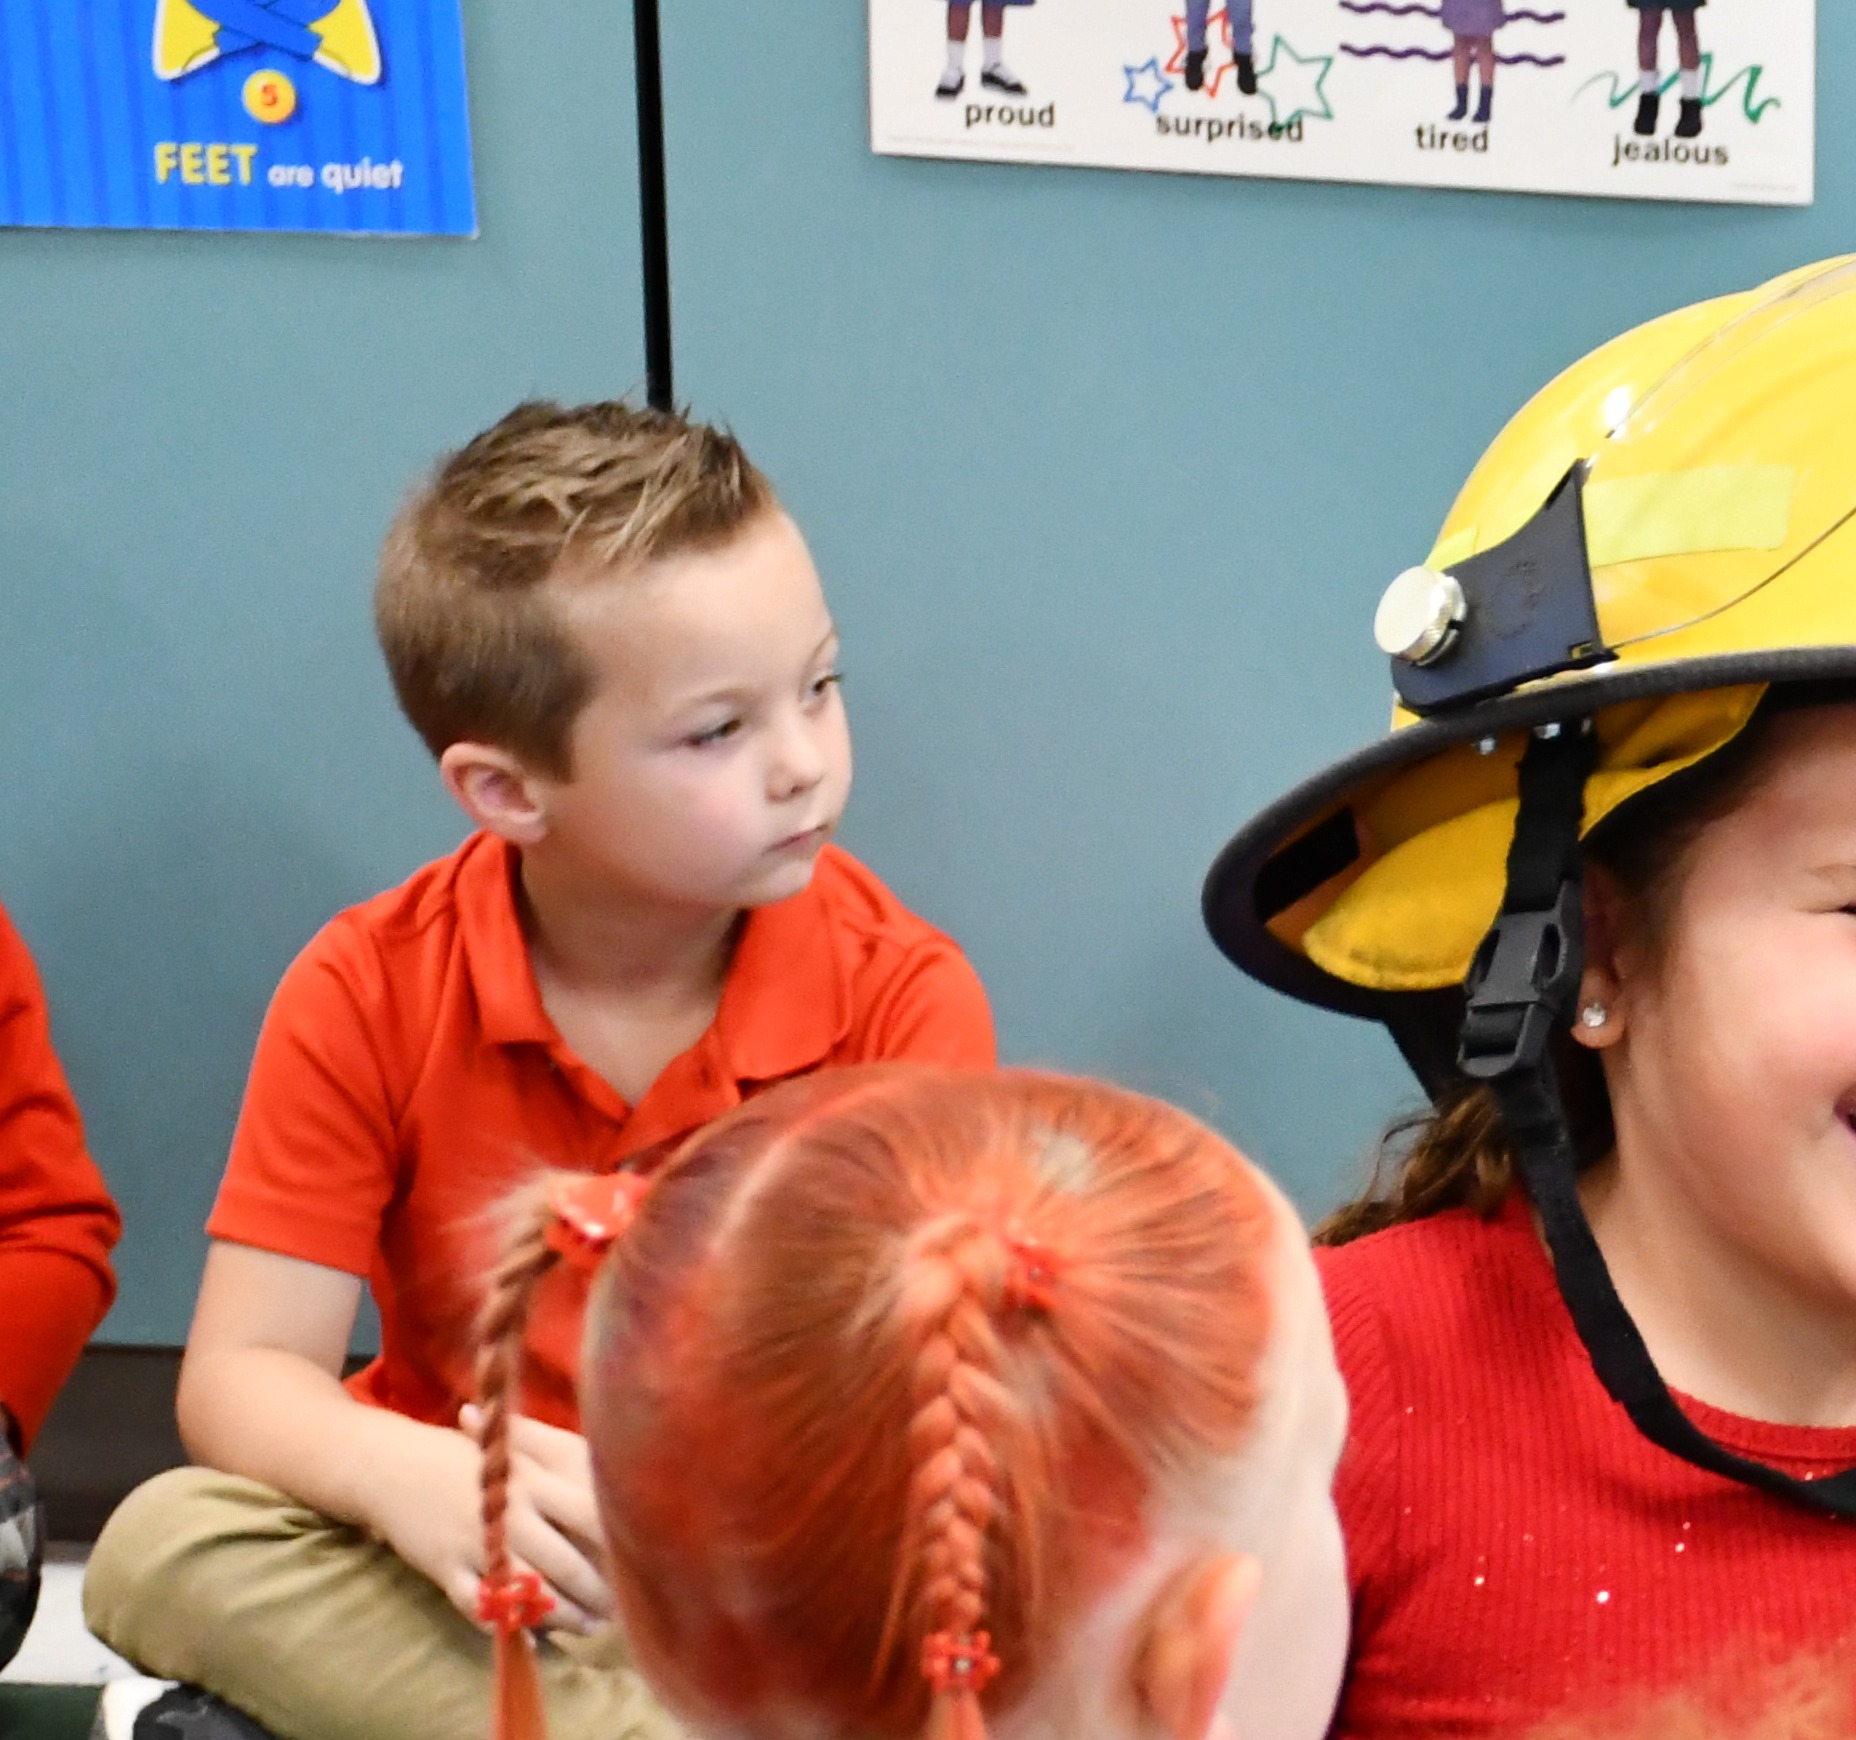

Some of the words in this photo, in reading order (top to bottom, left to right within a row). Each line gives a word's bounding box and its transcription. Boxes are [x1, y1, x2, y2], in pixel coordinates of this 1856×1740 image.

[964, 102, 1056, 128] proud
[1155, 112, 1304, 143] surprised
[1414, 123, 1490, 154] tired
[1610, 133, 1730, 167] jealous
[154, 142, 258, 186] FEET
[267, 164, 314, 187] are
[321, 156, 405, 194] quiet
